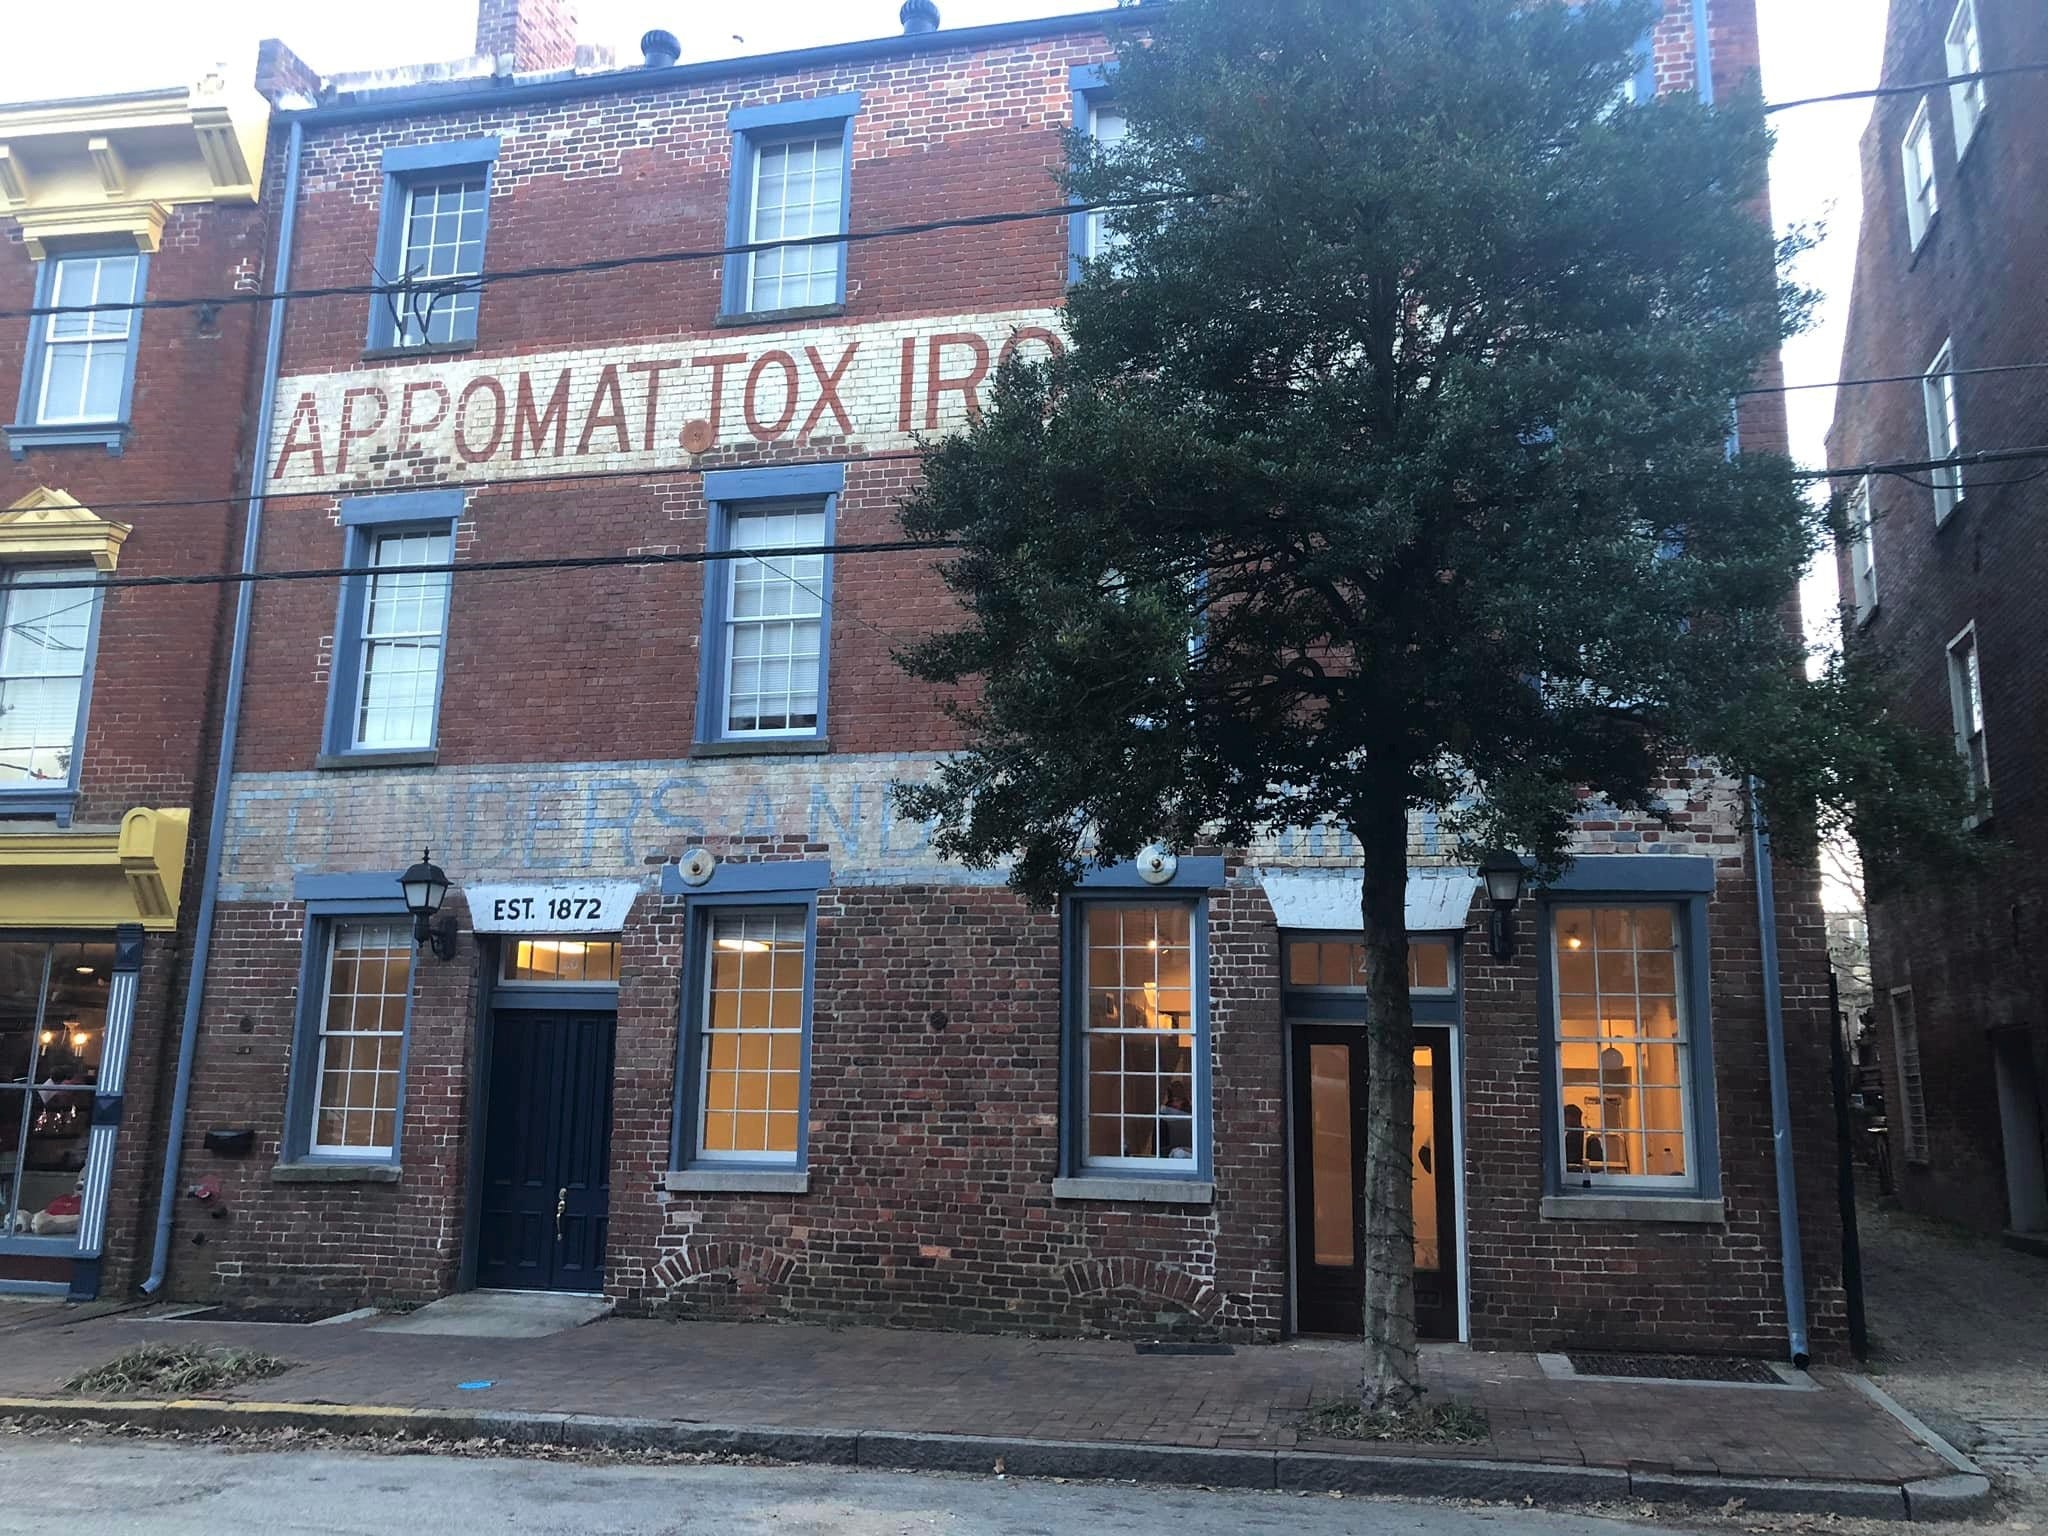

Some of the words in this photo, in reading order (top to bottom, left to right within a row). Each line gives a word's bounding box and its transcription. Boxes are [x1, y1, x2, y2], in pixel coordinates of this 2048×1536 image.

[273, 341, 860, 480] APPOMATTOX
[898, 326, 1066, 435] IRO
[230, 778, 709, 875] FONDERS
[738, 783, 940, 861] AND
[493, 898, 536, 921] EST.
[548, 897, 602, 920] 1872
